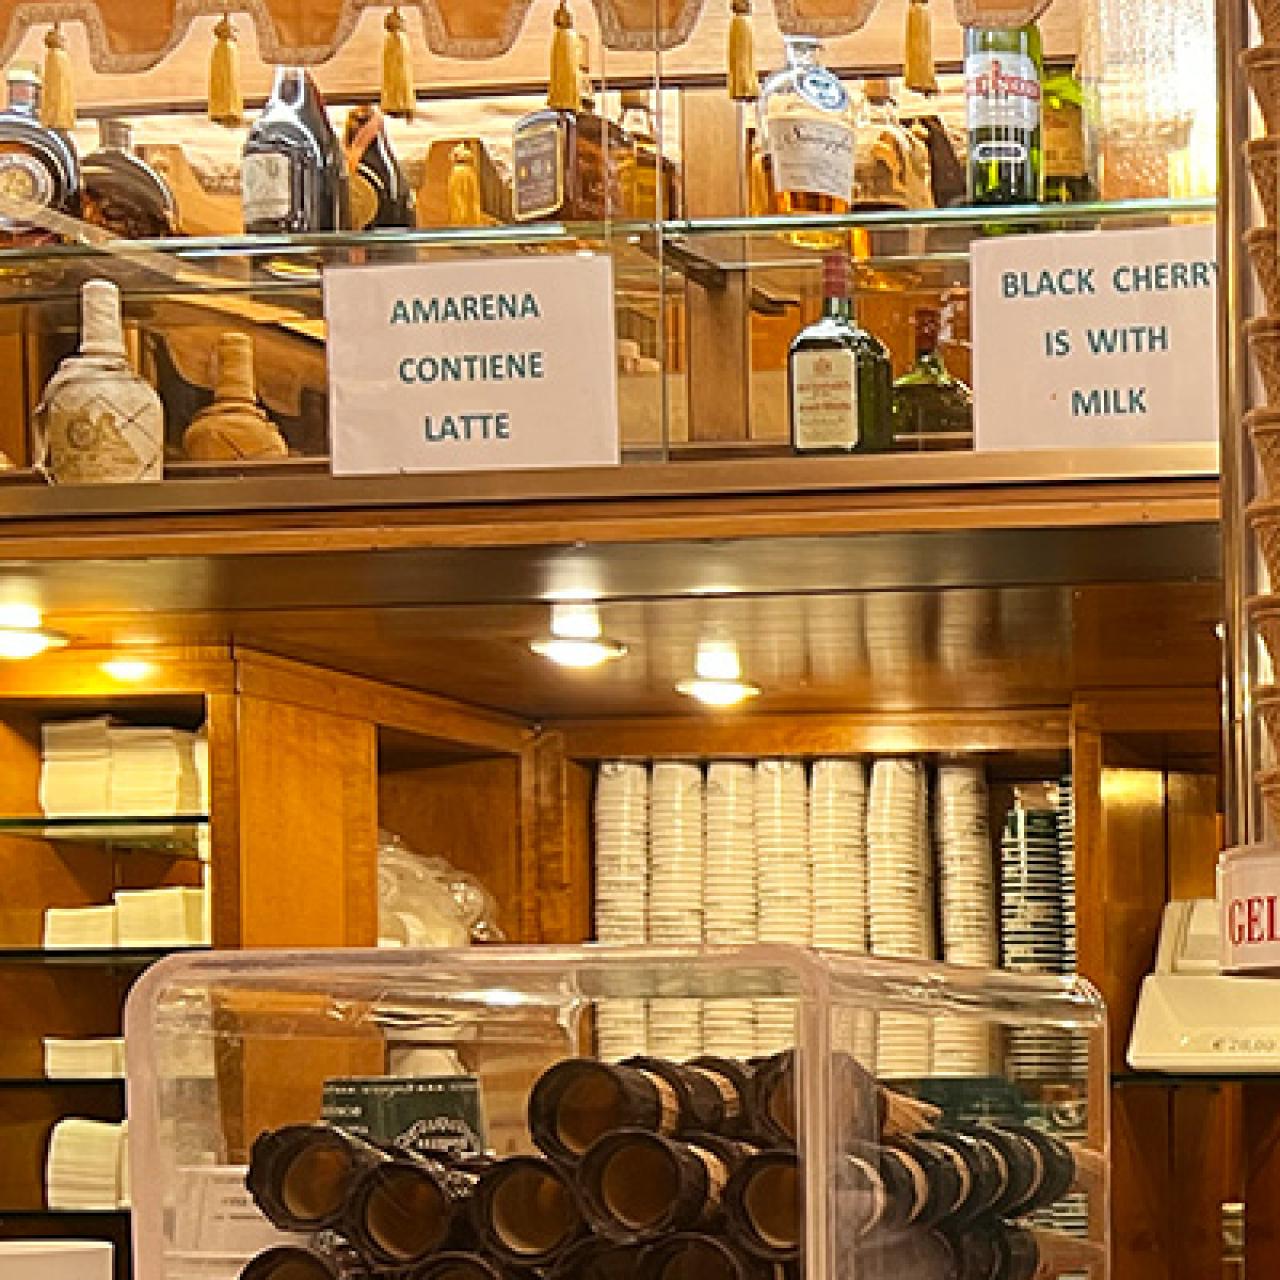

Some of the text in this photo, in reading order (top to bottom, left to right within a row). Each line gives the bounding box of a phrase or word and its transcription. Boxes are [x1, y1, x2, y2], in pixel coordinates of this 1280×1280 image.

[1002, 270, 1095, 298] BLACK
[390, 292, 540, 324] AMARENA
[1045, 326, 1168, 356] IS WITH
[398, 351, 543, 383] CONTIENE
[1071, 389, 1146, 416] MILK
[425, 414, 510, 441] LATTE
